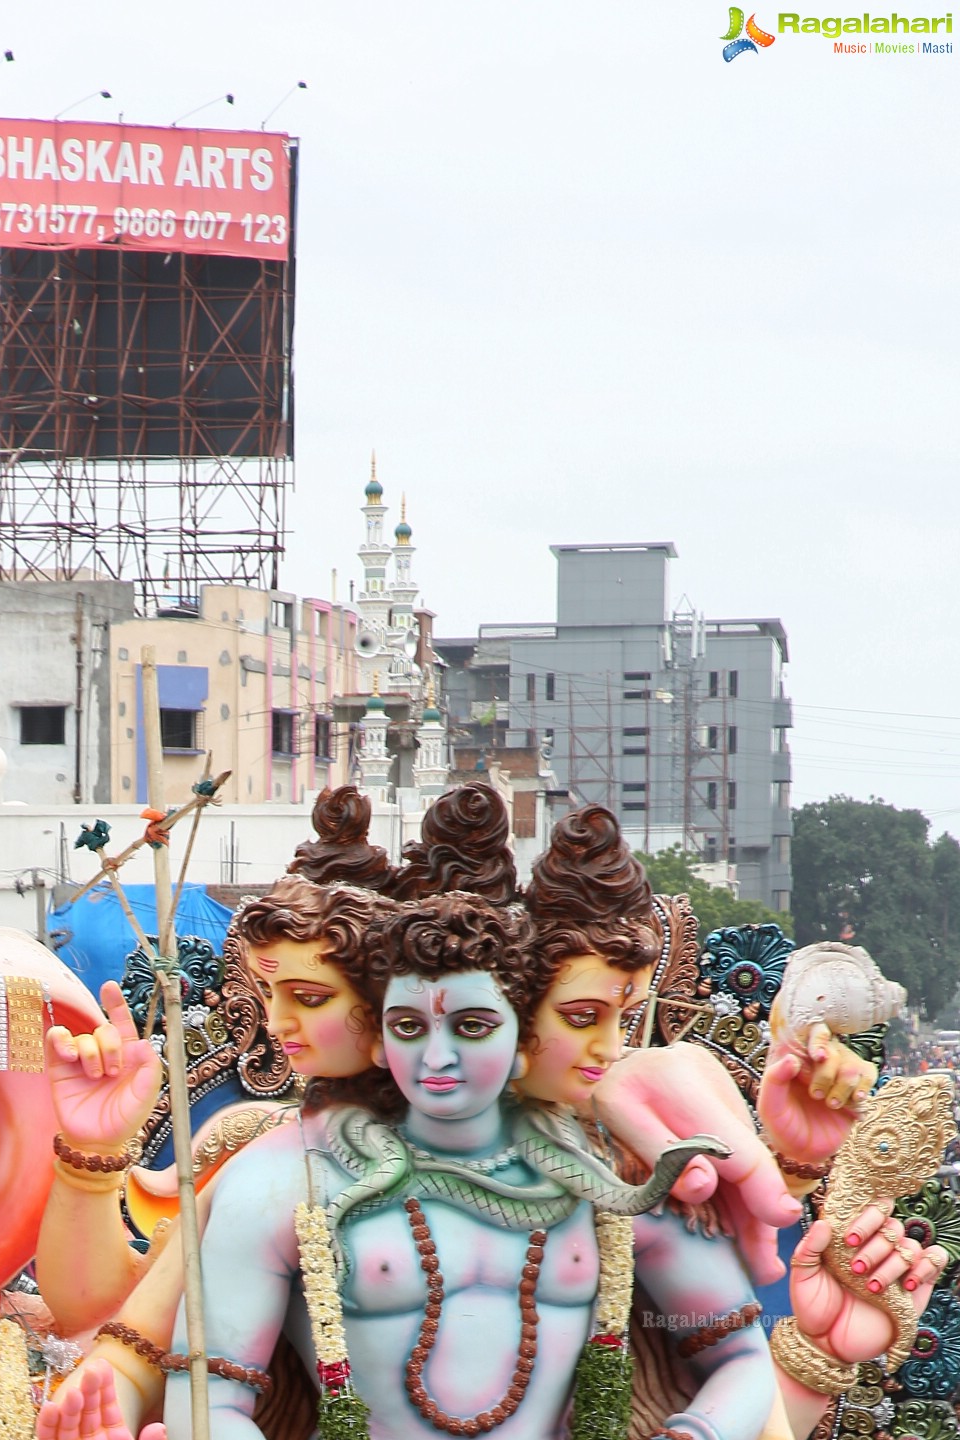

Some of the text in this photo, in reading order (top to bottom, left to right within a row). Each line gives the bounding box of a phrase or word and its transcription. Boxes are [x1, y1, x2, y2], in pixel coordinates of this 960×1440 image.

[174, 145, 275, 192] ARTS
[113, 207, 177, 240] 9866
[183, 210, 232, 241] 007
[240, 213, 287, 245] 123
